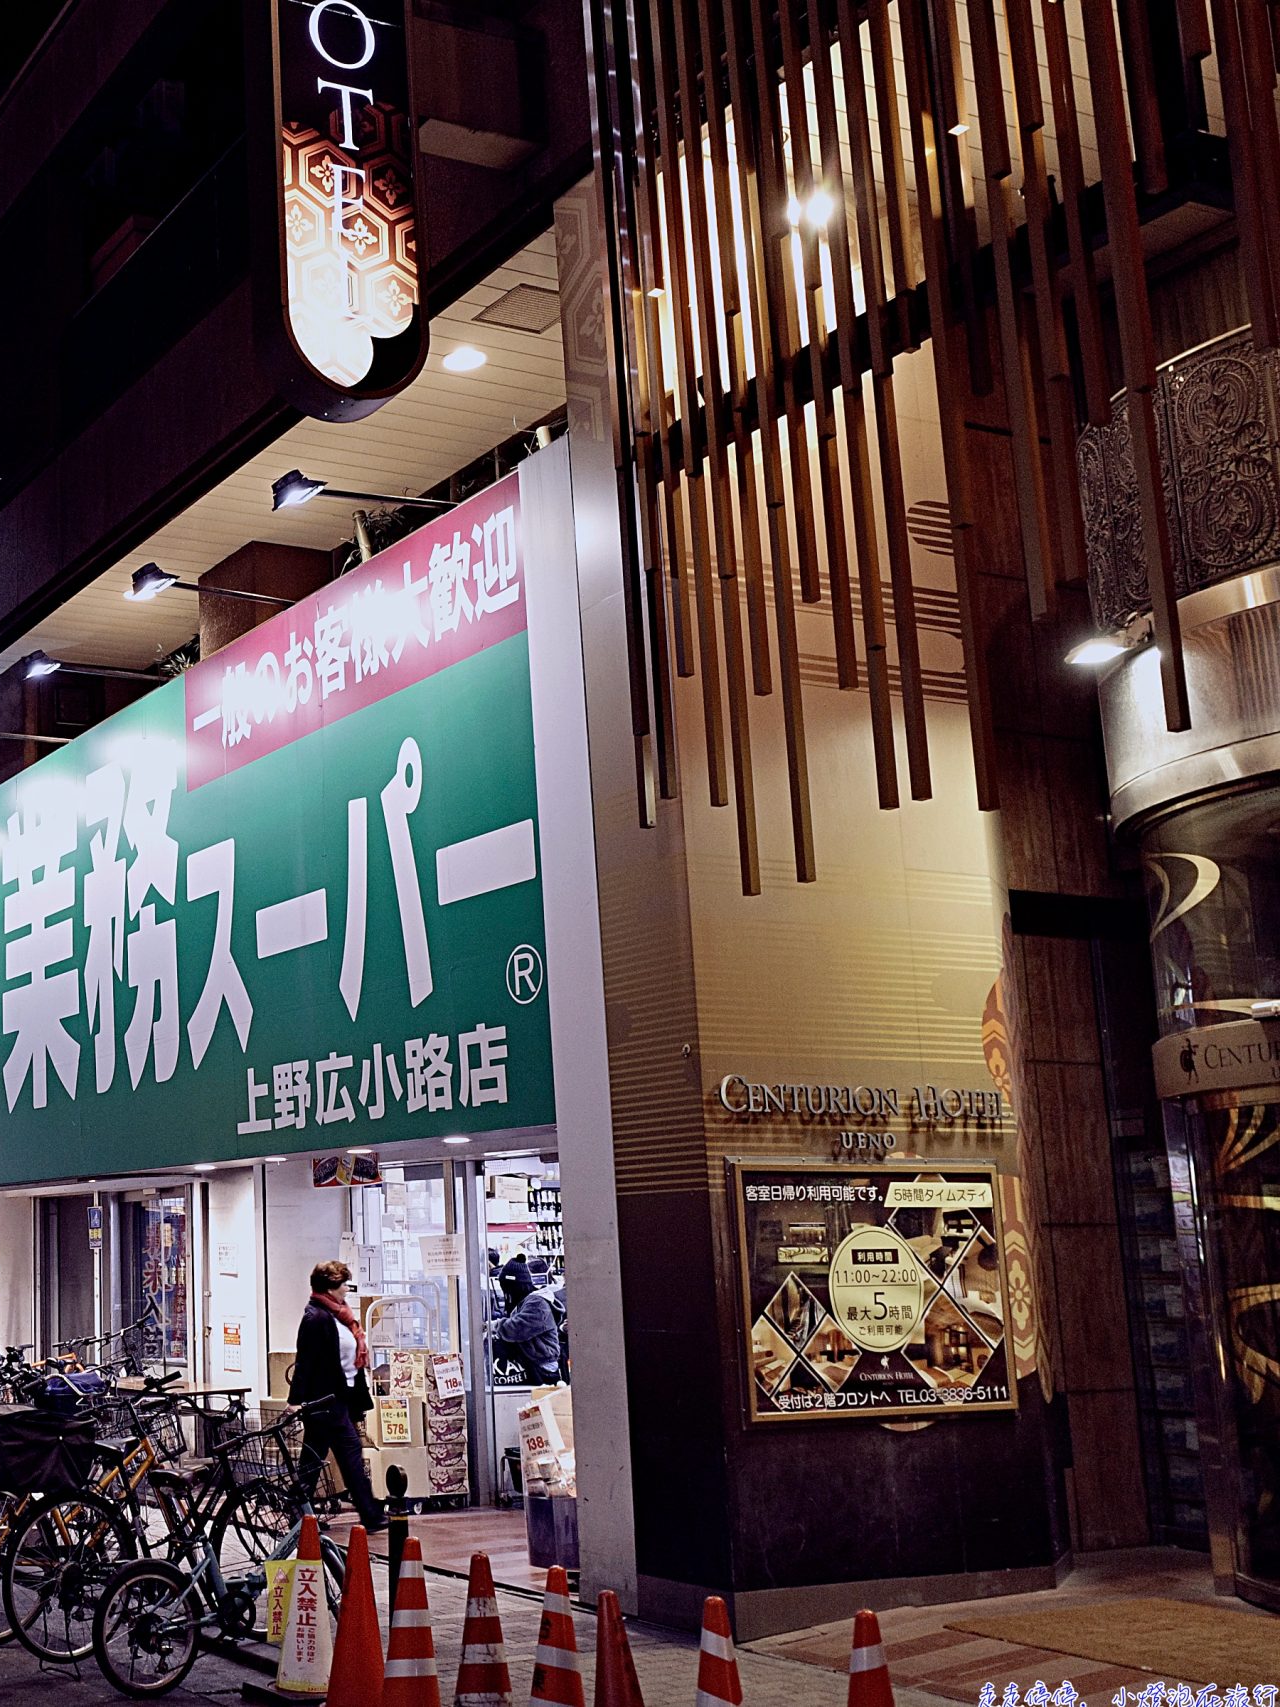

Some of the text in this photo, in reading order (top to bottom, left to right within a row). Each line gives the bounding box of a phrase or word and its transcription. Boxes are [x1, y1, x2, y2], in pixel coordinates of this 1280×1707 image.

[237, 1024, 510, 1137] 上野広小路店
[720, 1074, 1011, 1121] CENTURION HOTEL
[840, 1132, 896, 1149] UENO
[745, 1185, 884, 1202] 客室日帰り利用可能です。
[893, 1188, 987, 1202] 5時間タイムステイ
[856, 1251, 893, 1263] 利用時間
[847, 1291, 913, 1321] 最大5時間
[858, 1324, 904, 1336] ご利用可能
[494, 1374, 523, 1385] COFFEE
[859, 1372, 894, 1382] CENTURION
[778, 1386, 1008, 1410] 受付は2階フロントへ TEL03-3836-5111
[296, 1568, 318, 1627] 立入禁止
[272, 1585, 284, 1636] 立入禁止
[295, 1626, 305, 1663] お願いします
[306, 1627, 316, 1663] ご協力のほど
